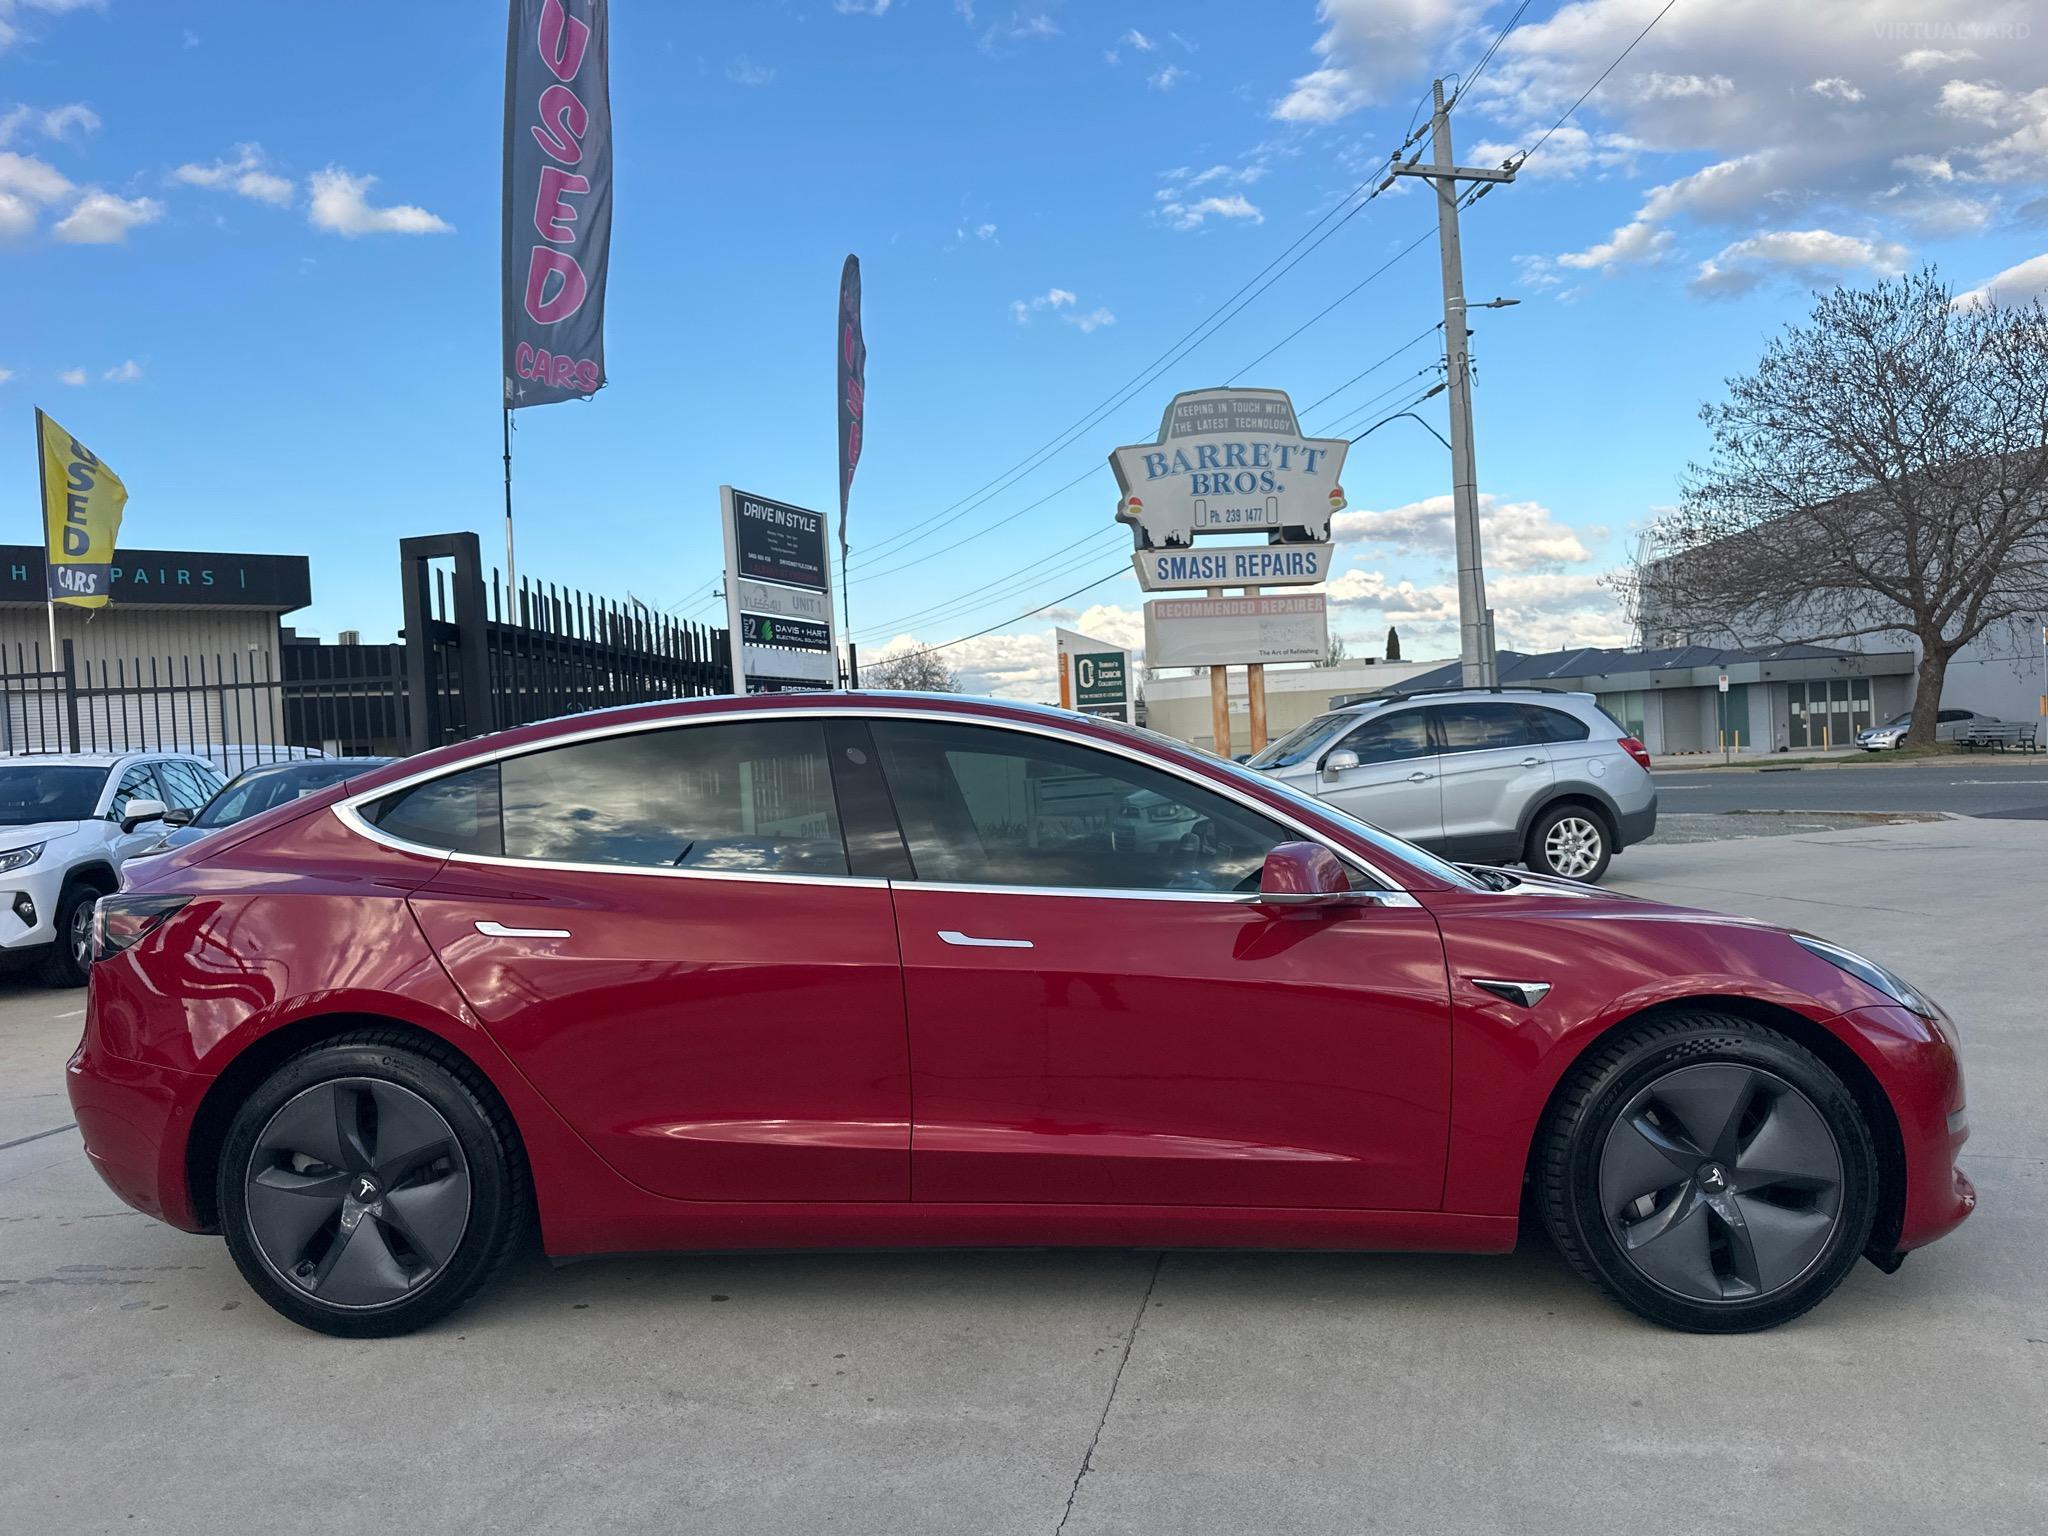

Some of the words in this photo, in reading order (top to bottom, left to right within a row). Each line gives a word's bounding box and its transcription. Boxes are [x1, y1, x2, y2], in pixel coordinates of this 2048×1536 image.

[525, 0, 591, 324] USED
[515, 341, 599, 393] CARS
[1177, 402, 1214, 417] KEEPING
[1217, 402, 1229, 413] IN
[1231, 401, 1261, 414] TOUCH
[1265, 402, 1287, 414] WITH
[1174, 422, 1192, 432] THE
[1197, 418, 1229, 431] LATEST
[1235, 417, 1291, 431] TECHNOLOGY
[1141, 440, 1327, 481] BARRETT
[1190, 470, 1286, 497] BROS.
[743, 502, 774, 523] DRIVE
[775, 510, 785, 526] IN
[786, 513, 816, 533] STYLE
[1210, 510, 1221, 523] Ph.
[1226, 509, 1241, 523] 239
[1245, 508, 1263, 522] 1477
[1157, 555, 1227, 580] SMASH
[1235, 552, 1318, 578] REPAIRS
[57, 566, 97, 594] CARS
[110, 568, 214, 586] PAIRS
[792, 595, 814, 612] UNIT
[817, 600, 822, 613] 1
[1157, 601, 1255, 618] RECOMMENDED
[1261, 598, 1323, 614] REPAIRER
[748, 618, 757, 639] 2
[775, 624, 800, 635] DAVIS
[806, 629, 828, 638] HART
[776, 634, 804, 642] ELECTRICAL
[804, 637, 828, 645] SOLUTIONS
[1290, 648, 1319, 656] Refinishing
